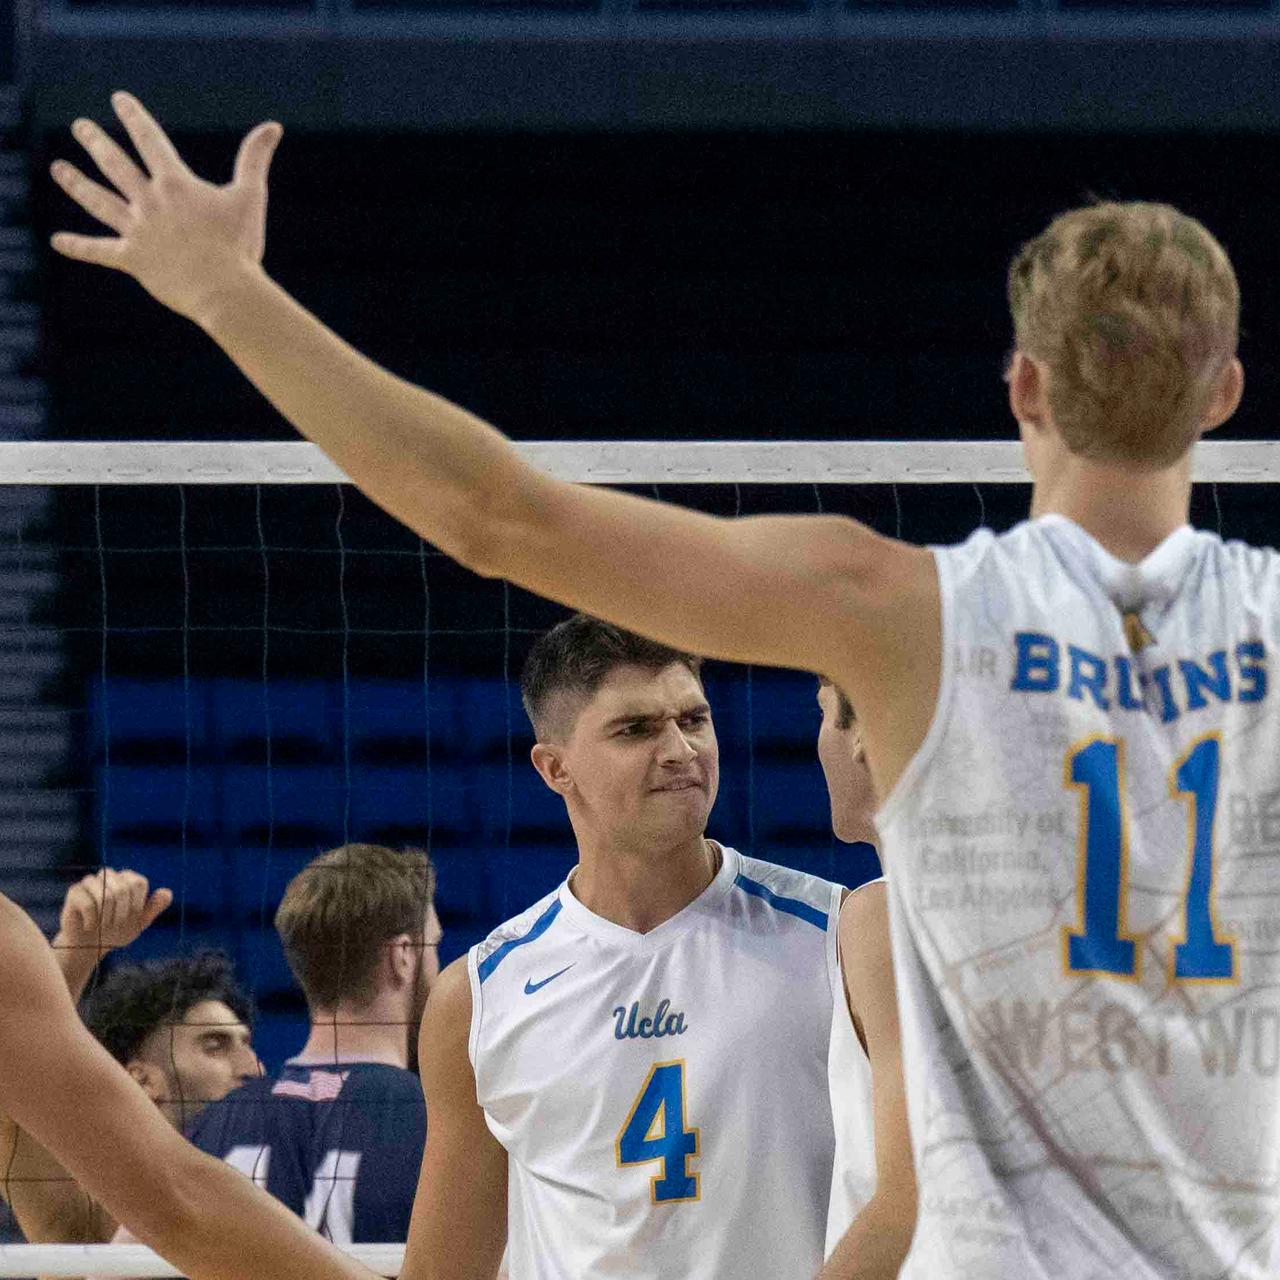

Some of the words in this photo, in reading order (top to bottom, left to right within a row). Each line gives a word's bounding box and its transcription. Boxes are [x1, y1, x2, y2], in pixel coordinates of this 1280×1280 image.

[1012, 631, 1268, 723] BRUINS
[1061, 730, 1241, 985] 11
[612, 998, 688, 1040] Ucla
[614, 1059, 703, 1205] 4
